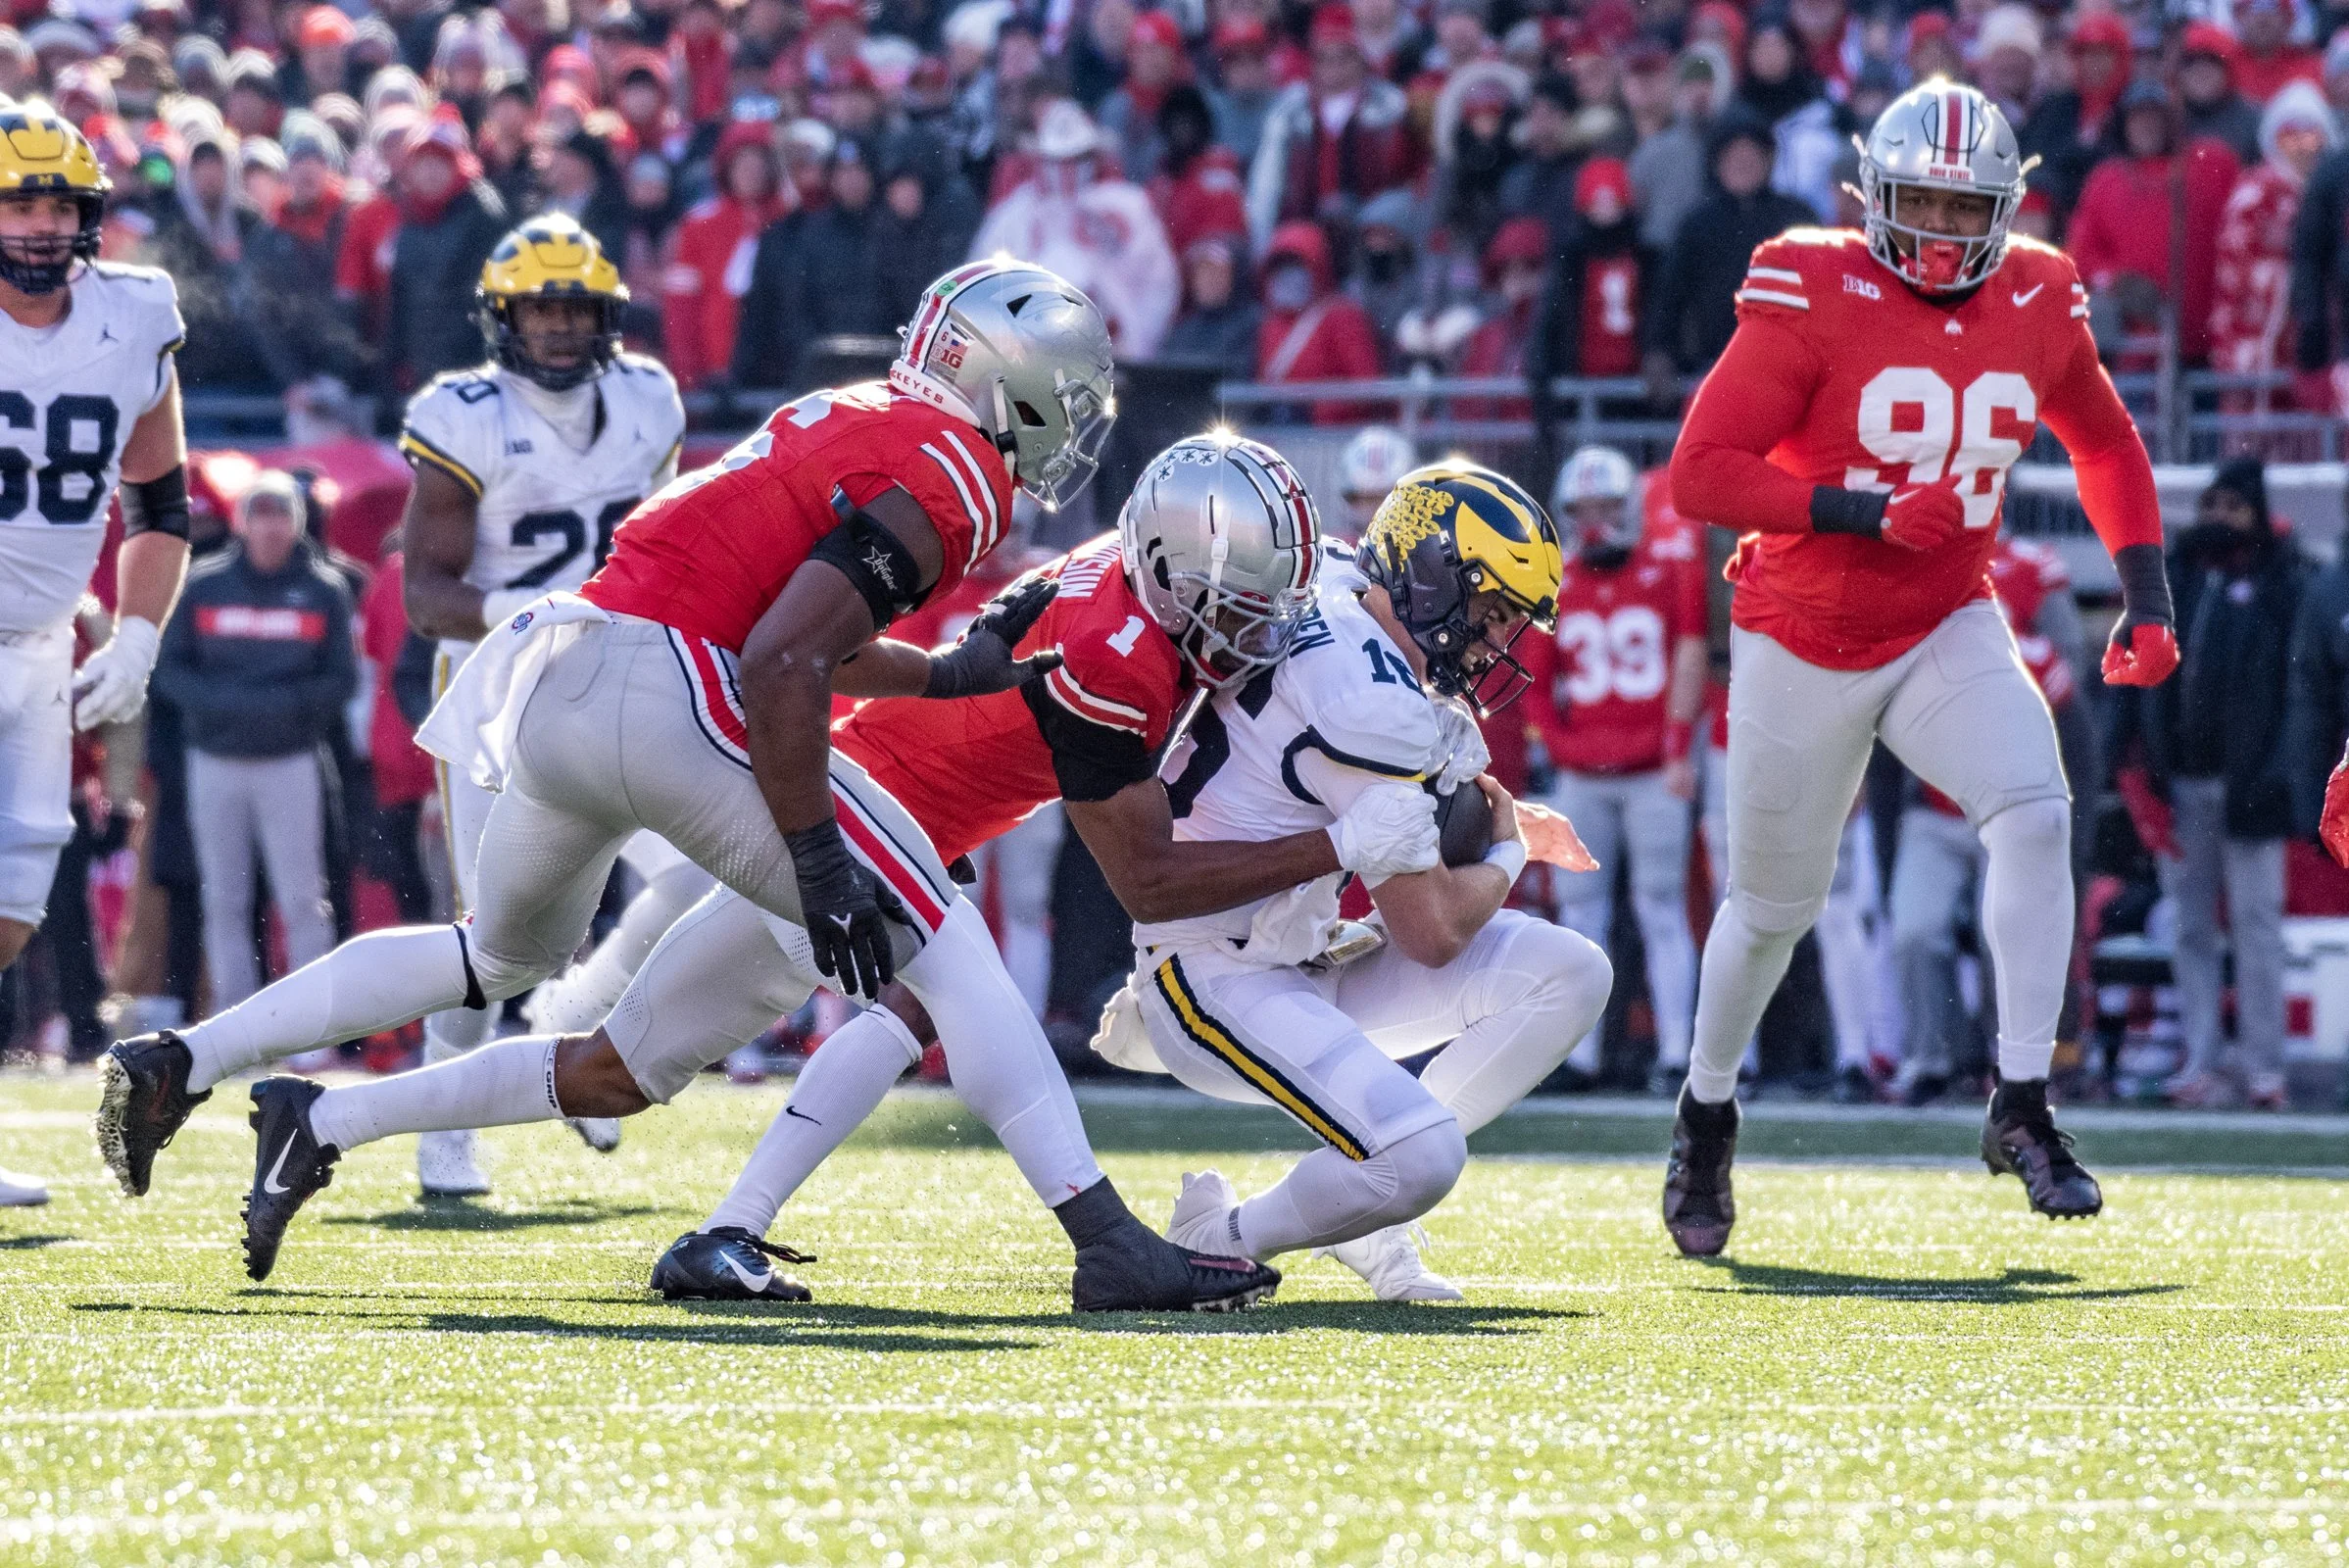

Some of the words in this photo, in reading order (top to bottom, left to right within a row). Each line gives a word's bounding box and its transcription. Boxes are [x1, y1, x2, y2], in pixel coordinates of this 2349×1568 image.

[941, 331, 950, 342] 6
[1843, 366, 2037, 529] 96
[1105, 614, 1147, 658] 1
[1556, 608, 1666, 706] 39
[546, 1070, 558, 1108] GRIP
